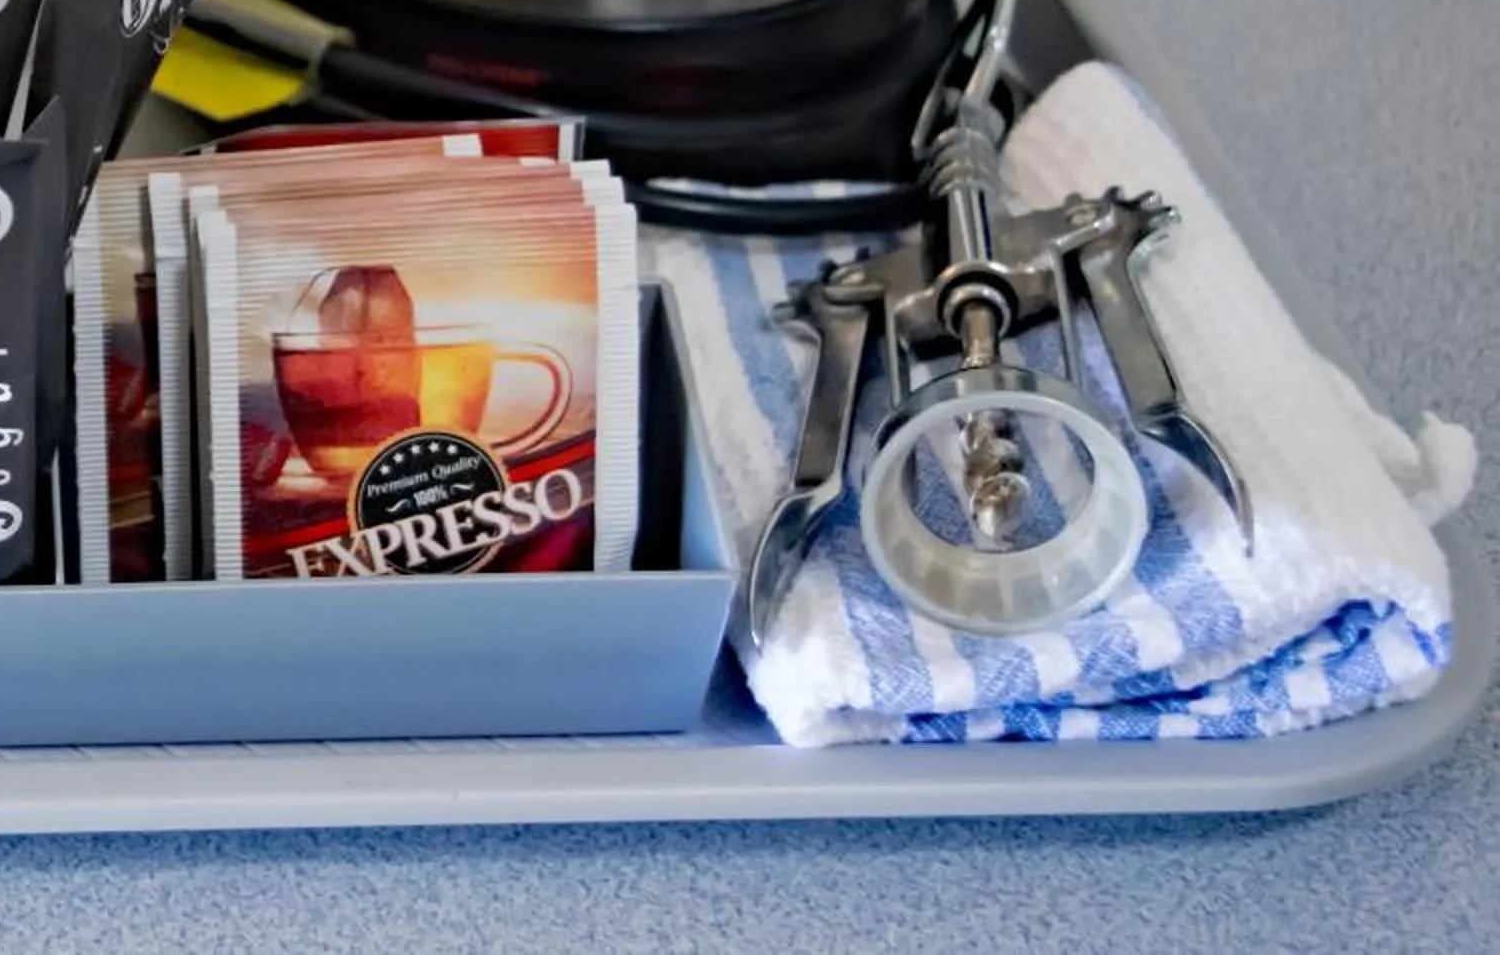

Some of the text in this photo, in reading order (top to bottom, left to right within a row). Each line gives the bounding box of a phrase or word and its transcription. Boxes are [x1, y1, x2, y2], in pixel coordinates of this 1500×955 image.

[367, 454, 482, 497] Premium Quality
[412, 483, 449, 508] 100%
[285, 468, 582, 577] EXPRESSO
